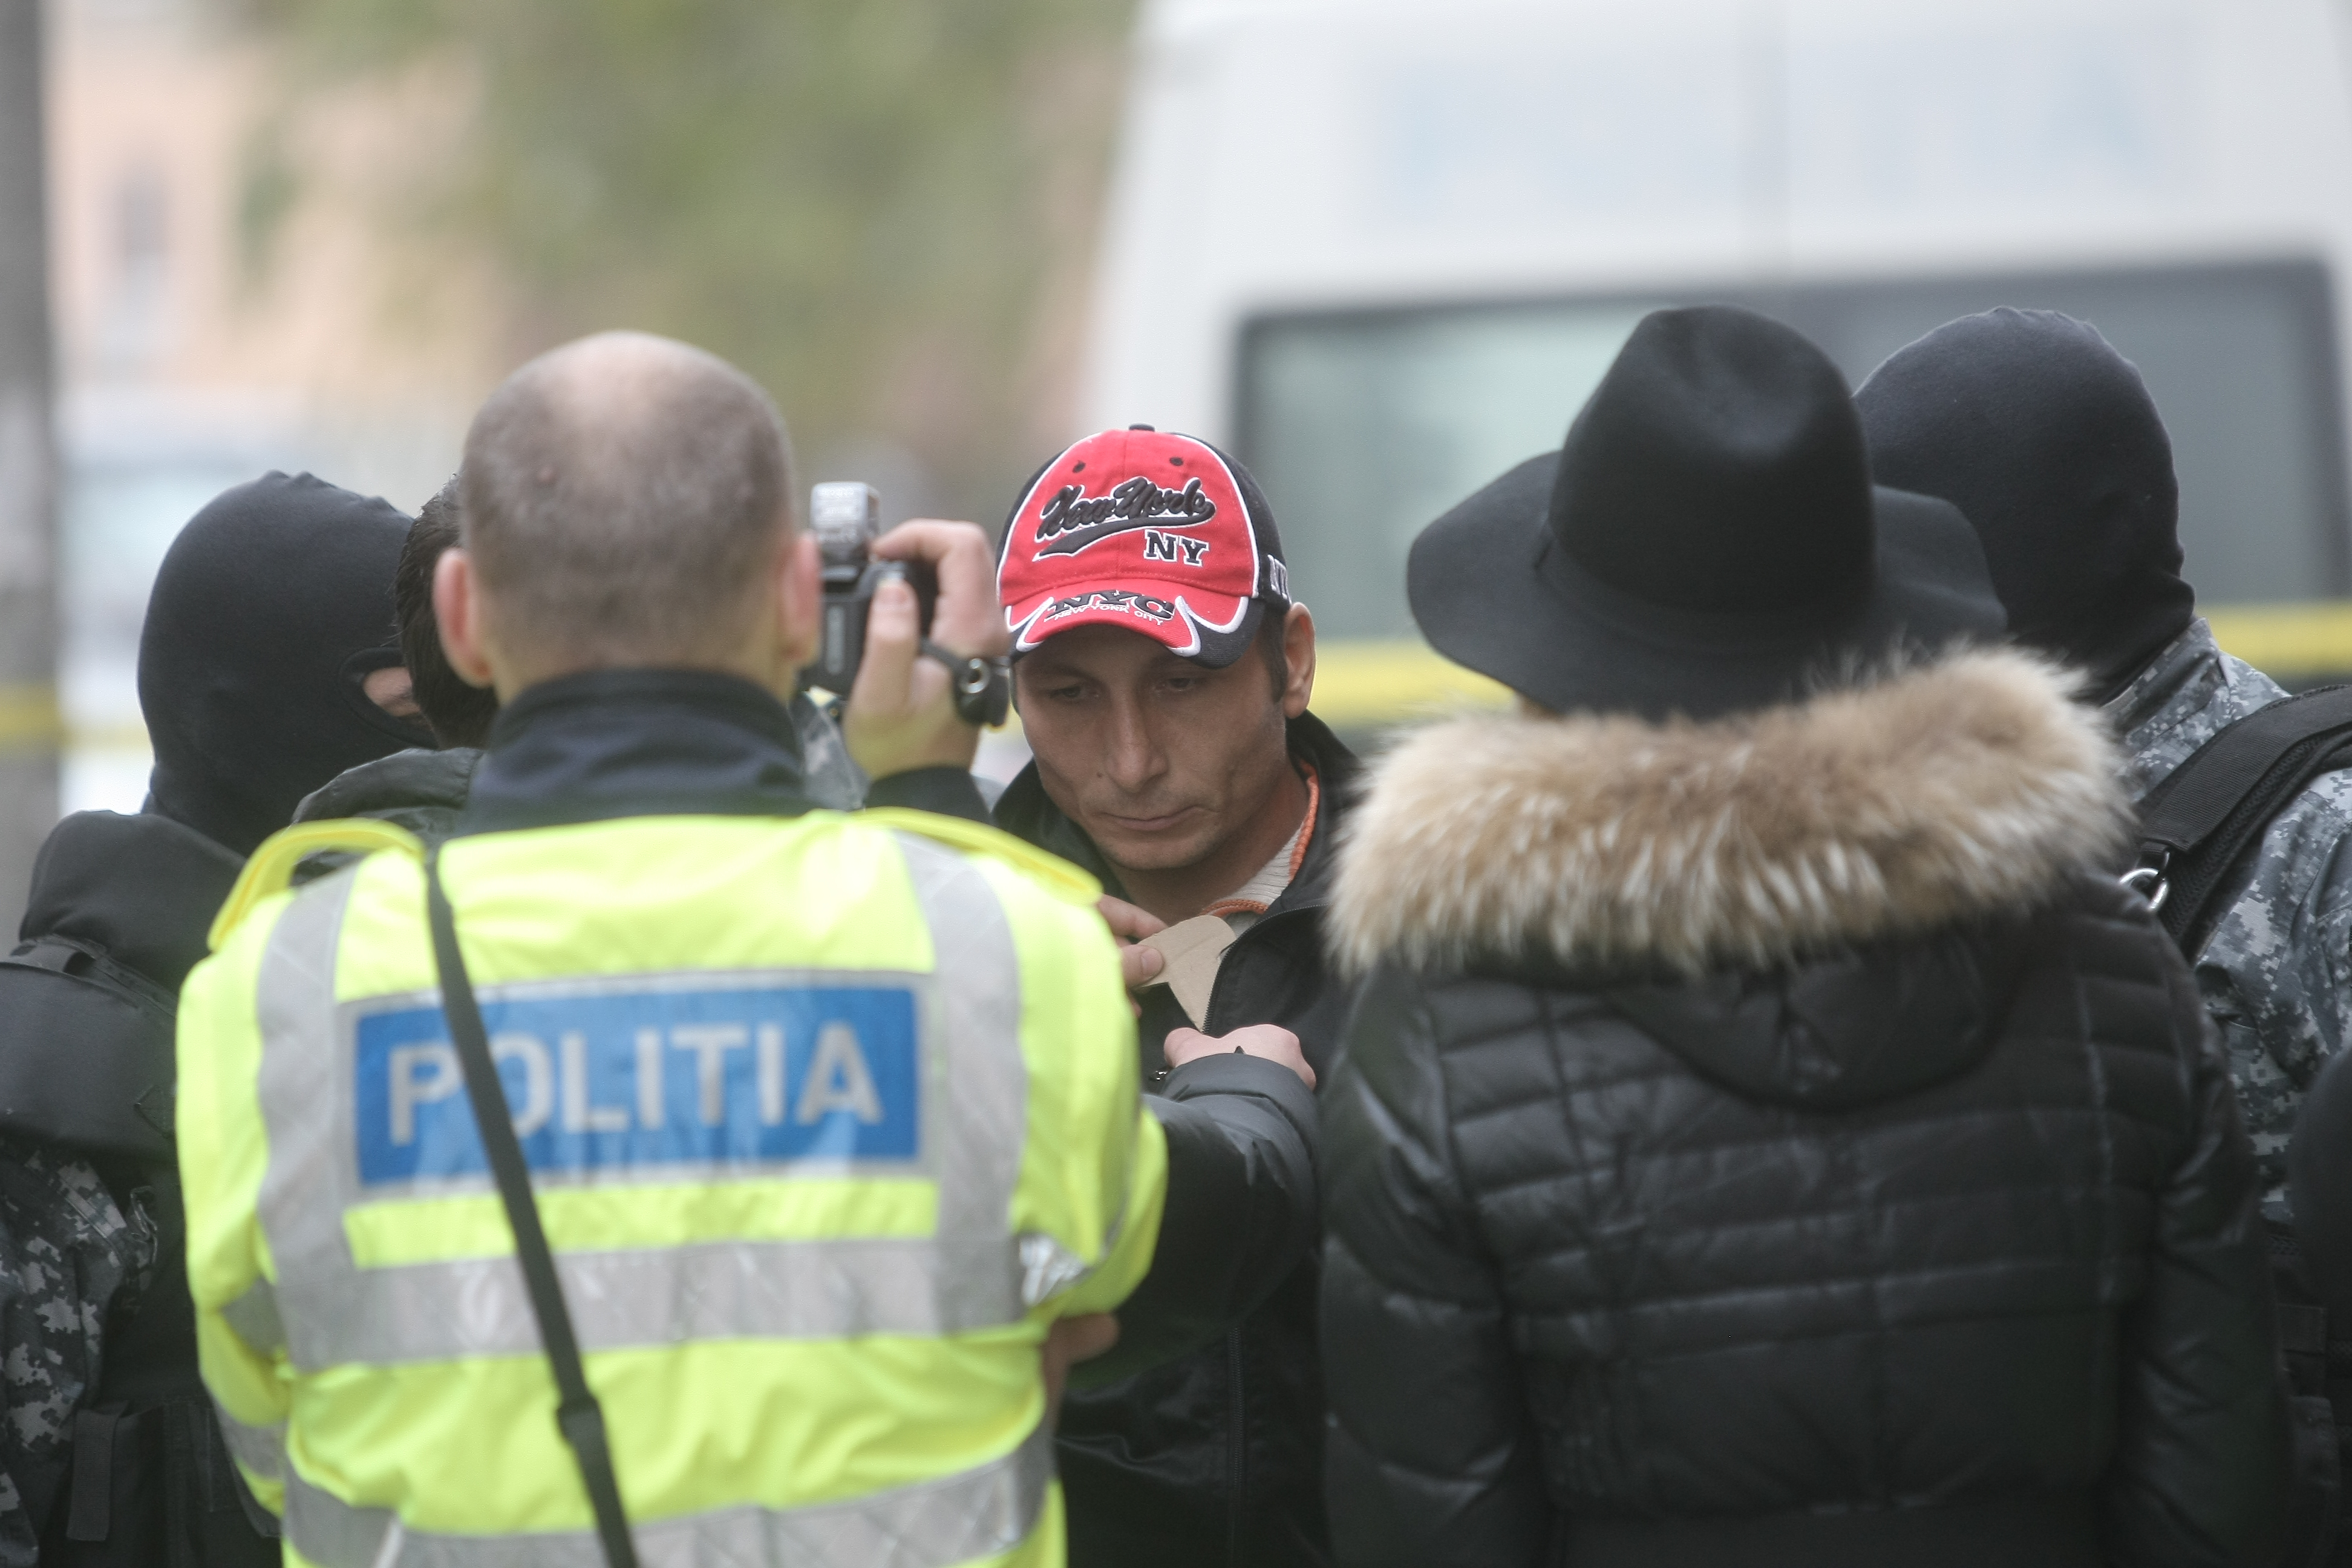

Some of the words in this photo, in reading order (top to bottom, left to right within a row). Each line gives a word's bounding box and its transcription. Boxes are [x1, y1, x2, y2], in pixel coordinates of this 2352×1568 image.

[1034, 484, 1117, 542] New
[1111, 476, 1209, 518] York
[1144, 529, 1209, 567] NY
[1044, 590, 1175, 622] NYC
[1054, 605, 1089, 620] NEW
[1092, 601, 1130, 613] YORK
[1134, 610, 1164, 626] CITY
